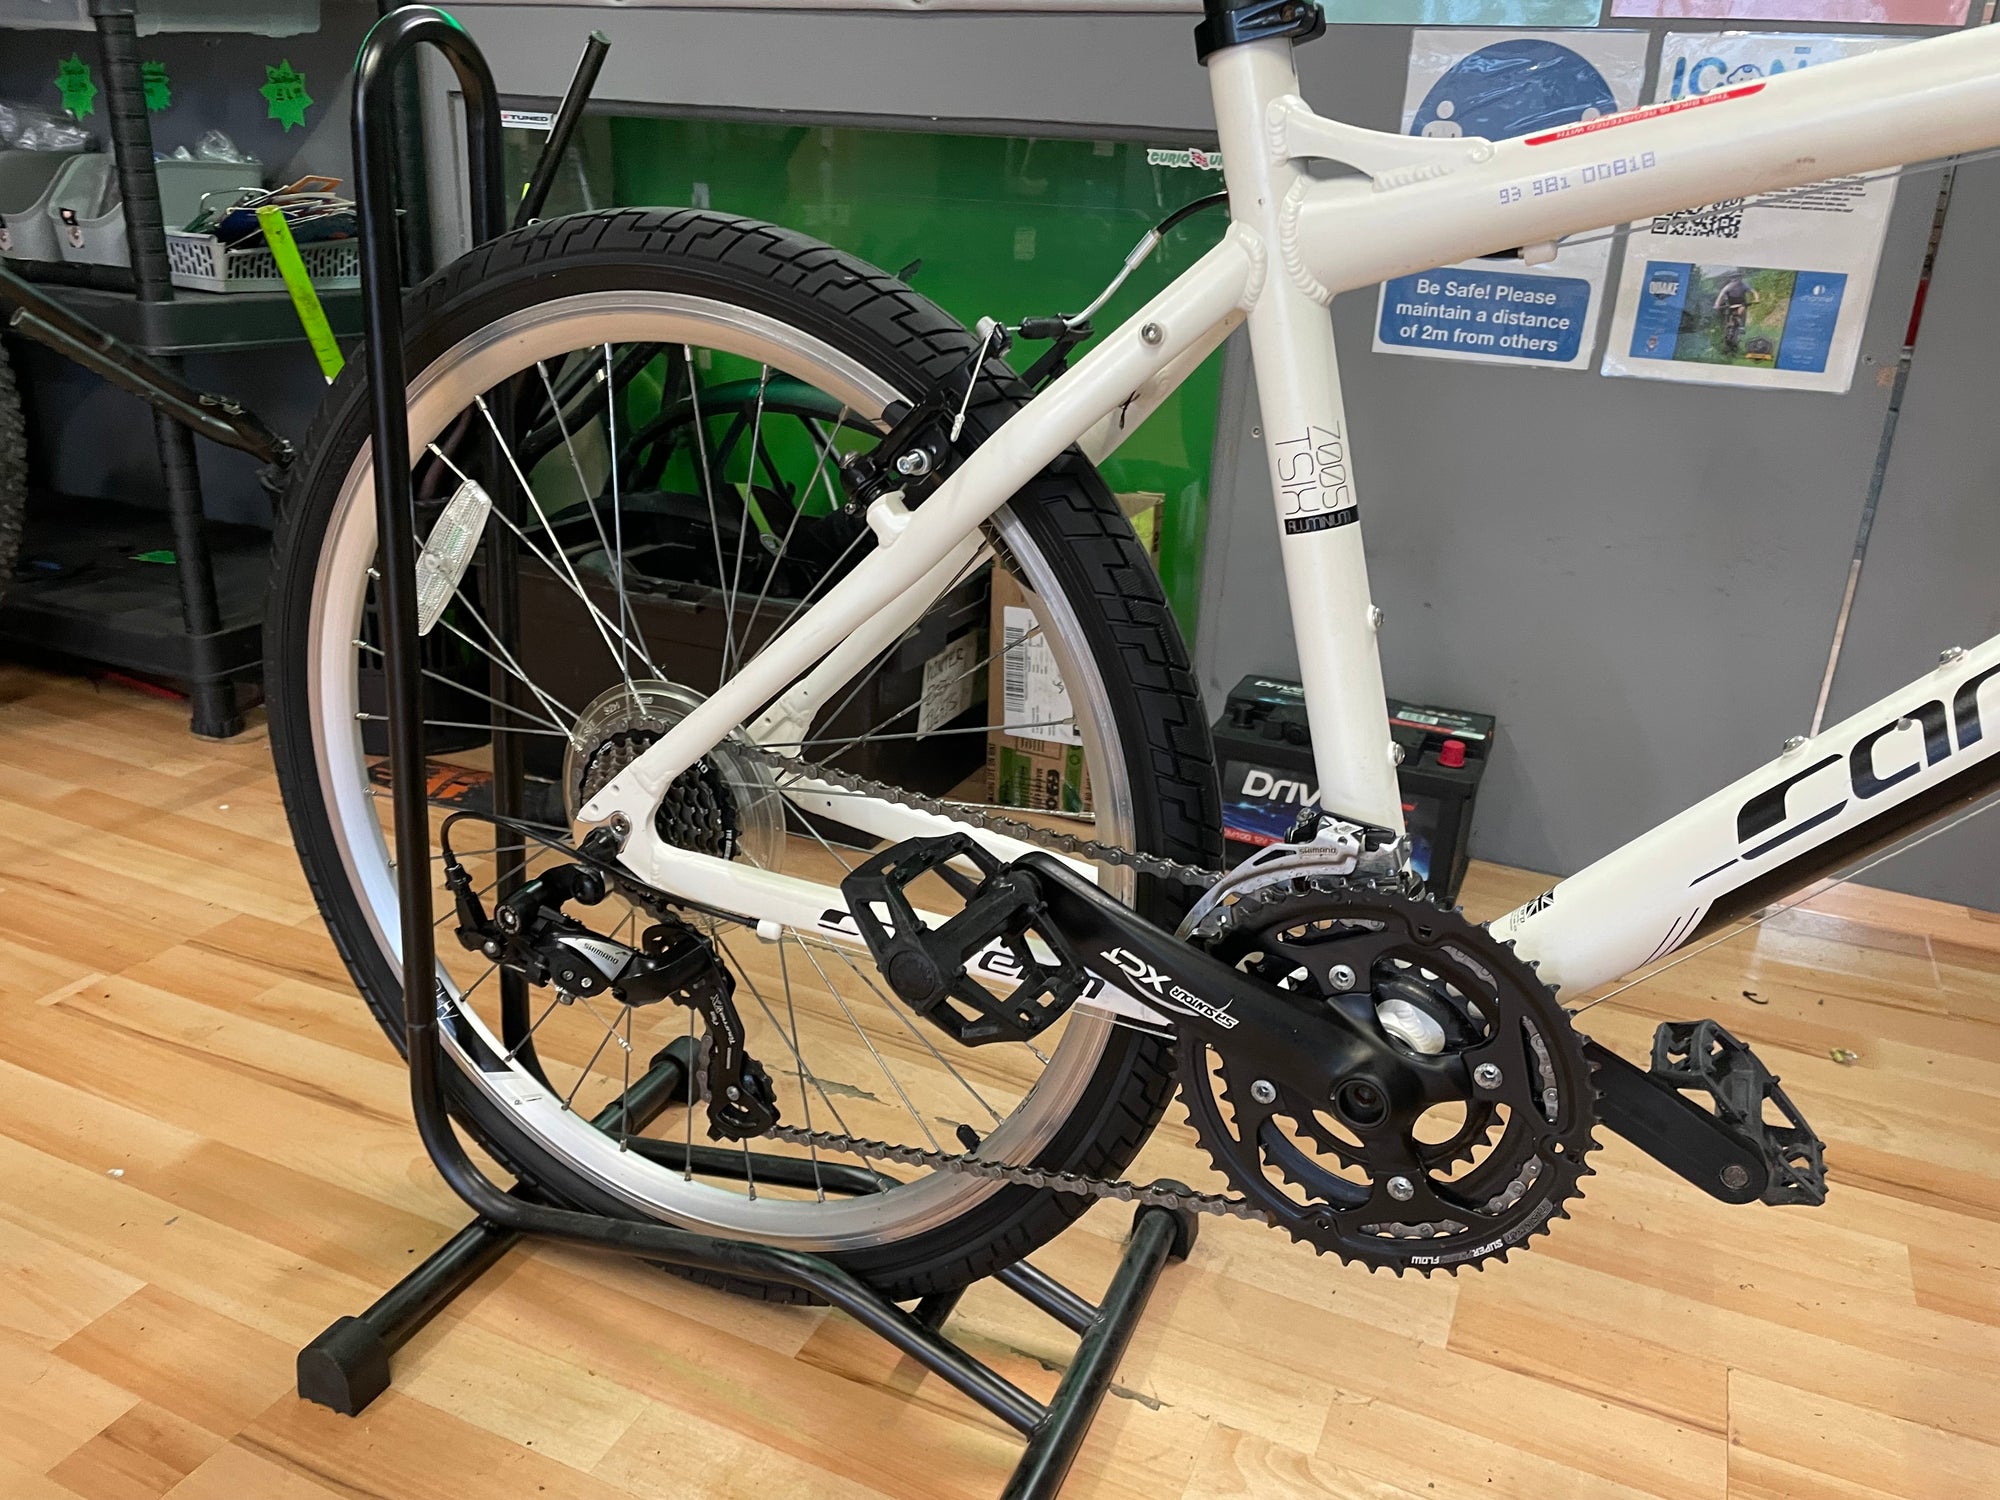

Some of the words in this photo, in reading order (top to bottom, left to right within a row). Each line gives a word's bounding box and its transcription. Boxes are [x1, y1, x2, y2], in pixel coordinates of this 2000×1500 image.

[1674, 98, 1700, 113] BIKE
[1701, 92, 1729, 106] THIS
[1587, 109, 1658, 131] REGISTERED
[1556, 125, 1586, 139] WITH
[1416, 278, 1441, 296] Be
[1444, 280, 1491, 300] Safe!
[1495, 285, 1557, 305] Please
[1395, 302, 1471, 321] maintain
[1475, 311, 1487, 323] a
[1492, 308, 1570, 330] distance
[1399, 324, 1418, 338] of
[1421, 325, 1448, 342] 2m
[1453, 328, 1495, 346] from
[1499, 333, 1558, 352] others
[1099, 946, 1172, 994] XCT
[1472, 1239, 1503, 1258] SUPER
[1411, 1255, 1440, 1265] FLOW
